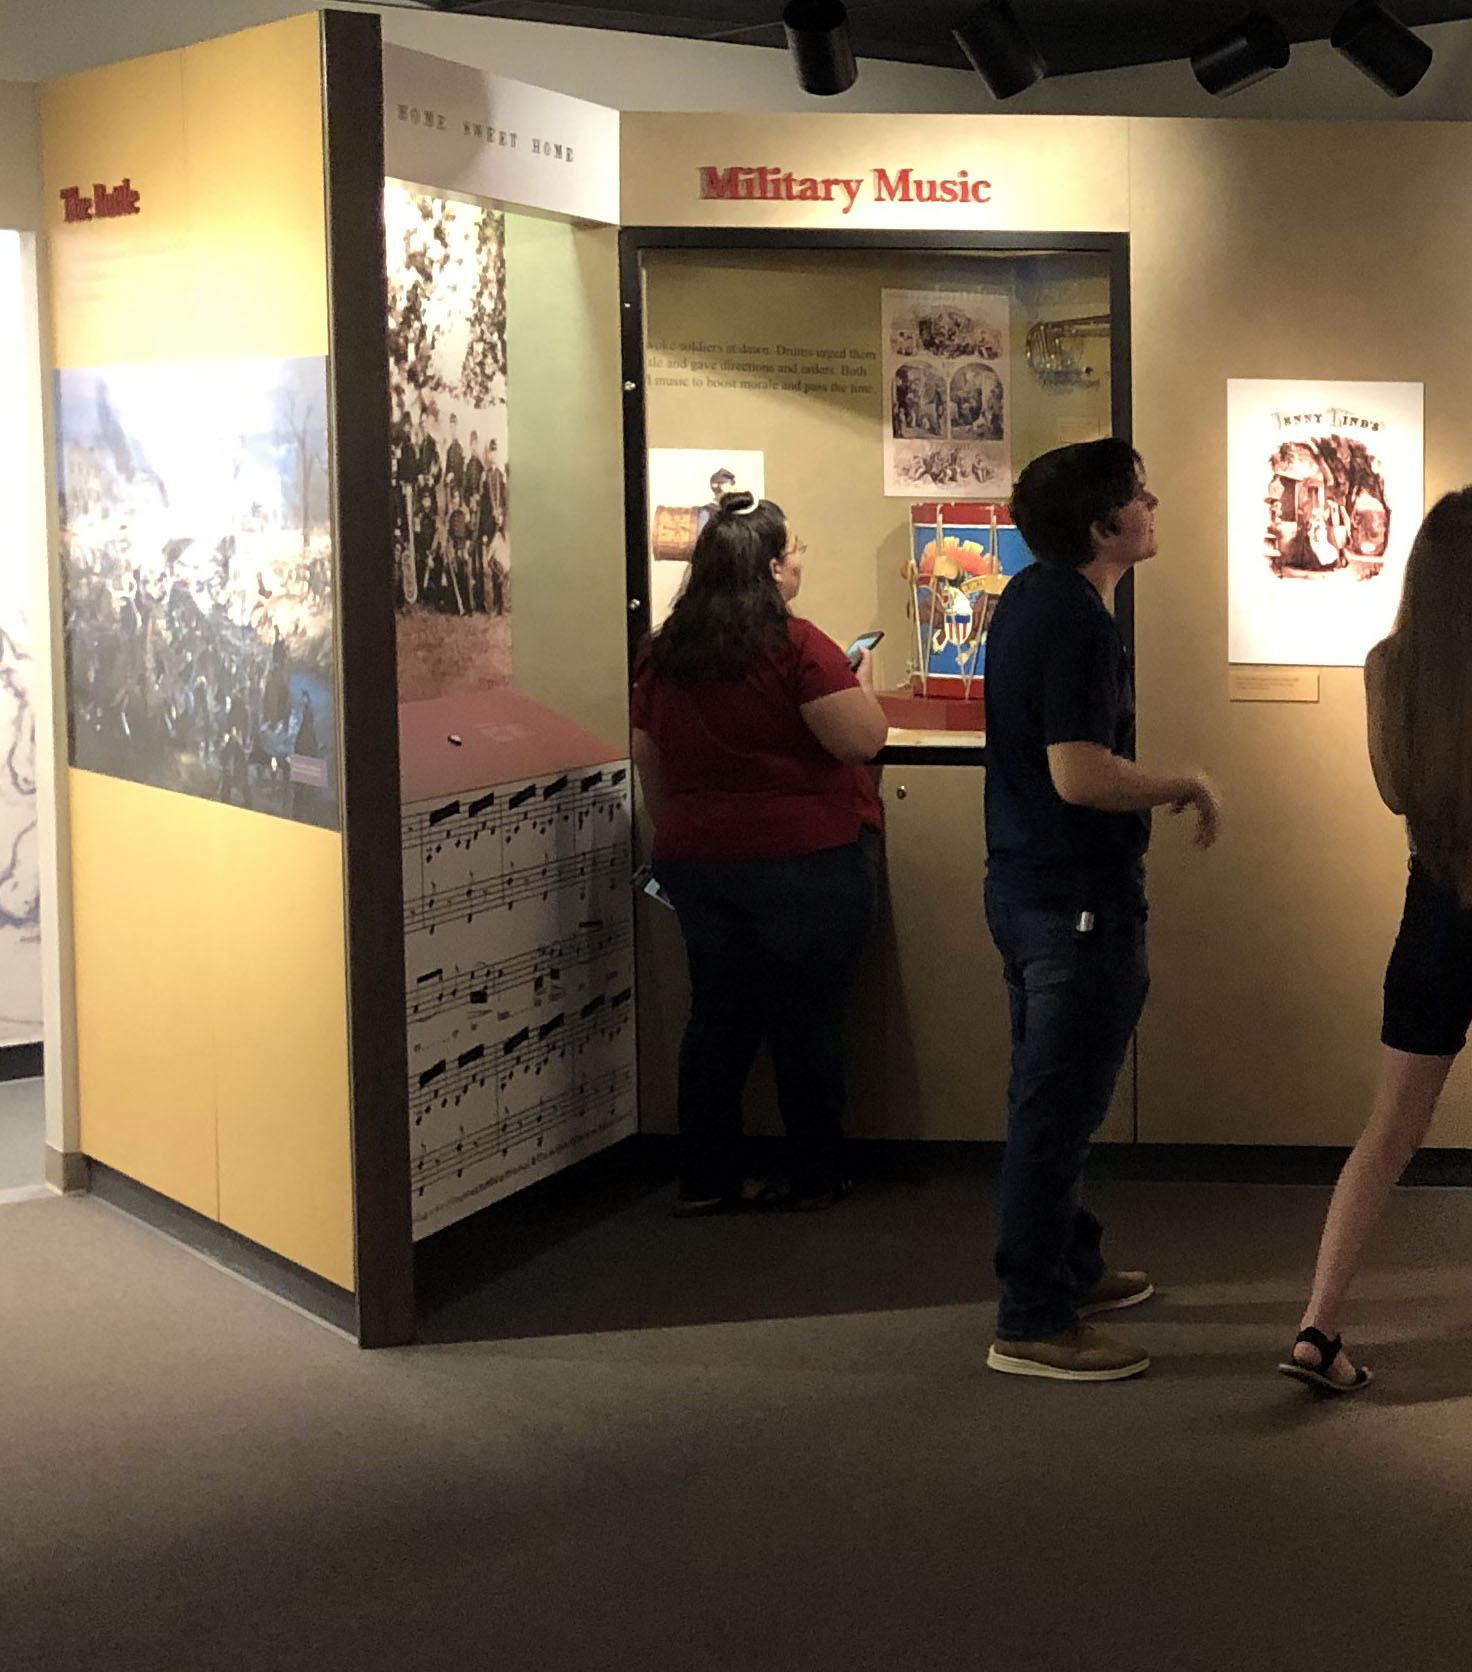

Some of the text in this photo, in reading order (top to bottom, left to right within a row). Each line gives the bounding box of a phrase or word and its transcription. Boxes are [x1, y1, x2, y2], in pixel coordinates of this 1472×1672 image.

[397, 104, 574, 163] HOME SWEET HOME
[697, 166, 992, 215] Military Music
[667, 359, 687, 368] and
[690, 361, 718, 371] gave
[778, 364, 798, 374] and
[692, 377, 703, 387] to
